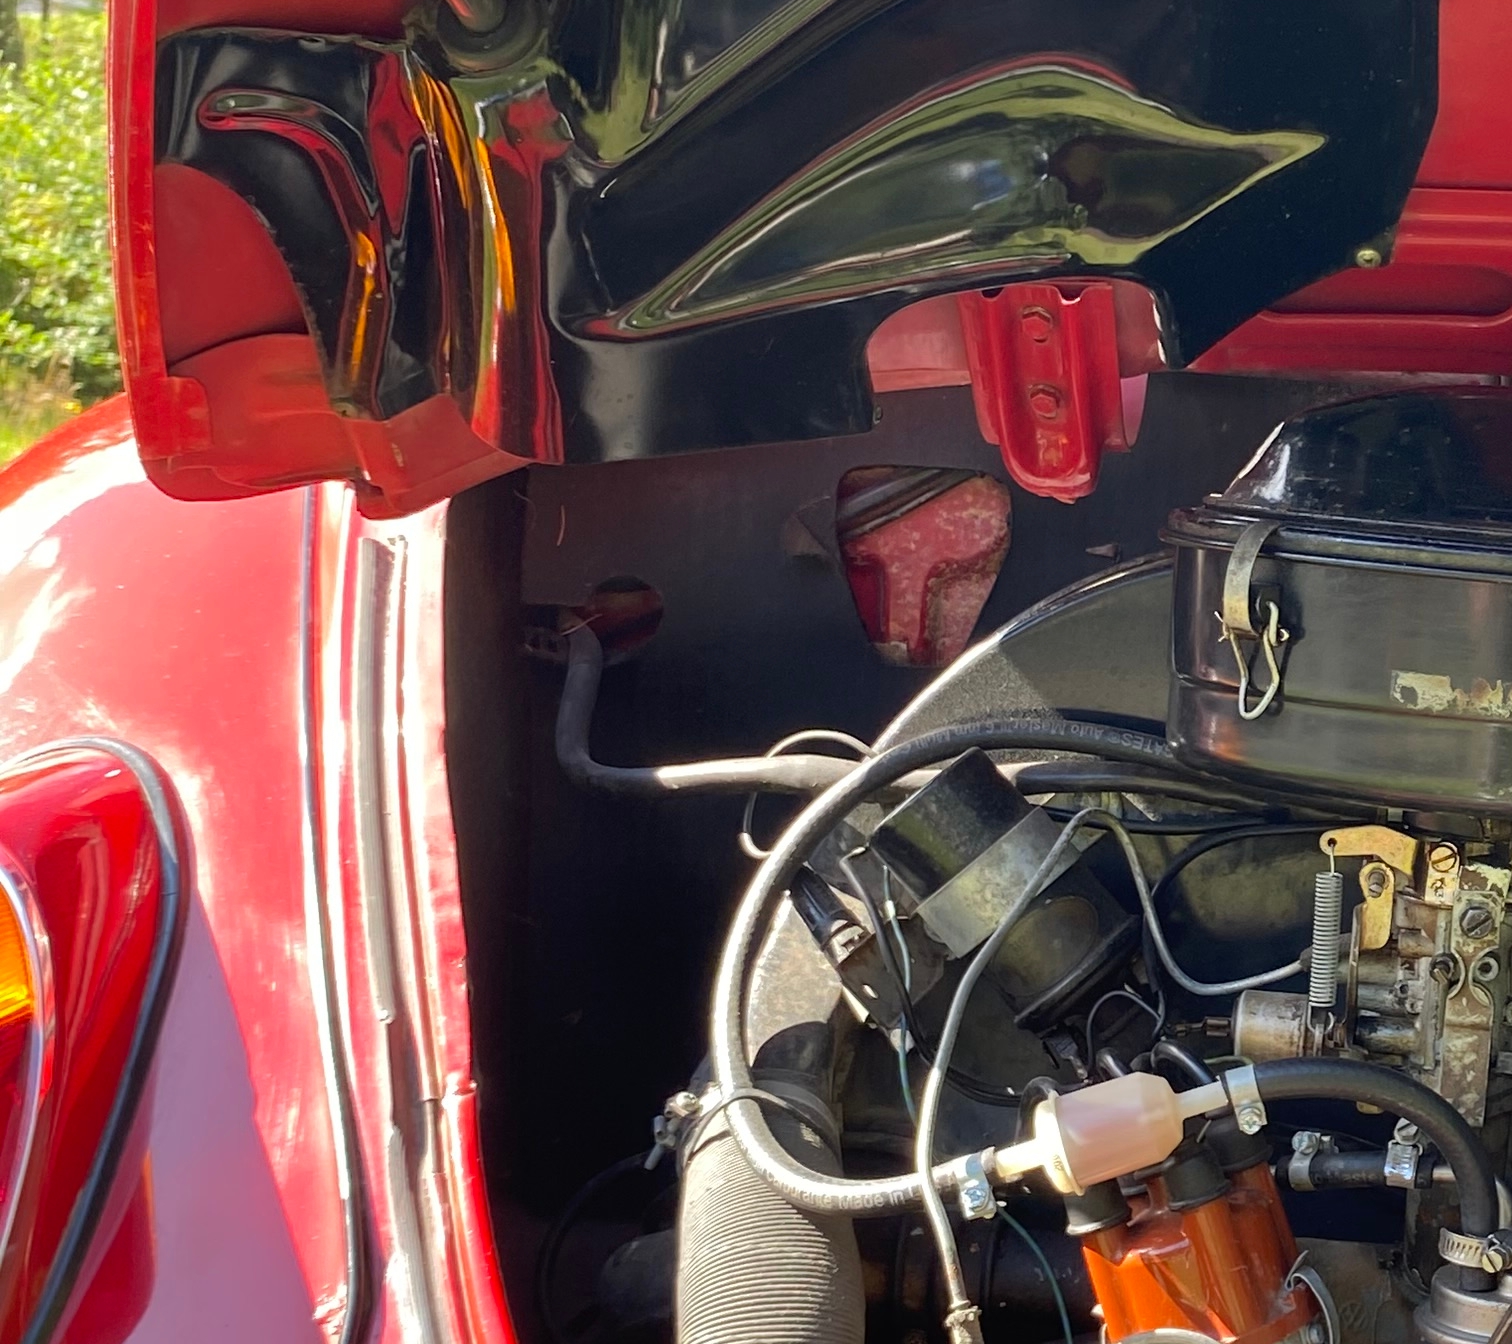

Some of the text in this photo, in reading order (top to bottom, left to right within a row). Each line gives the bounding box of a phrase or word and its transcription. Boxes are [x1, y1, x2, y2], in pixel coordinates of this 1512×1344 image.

[1070, 722, 1105, 741] Auto
[838, 1191, 884, 1210] Made
[890, 1188, 906, 1206] in
